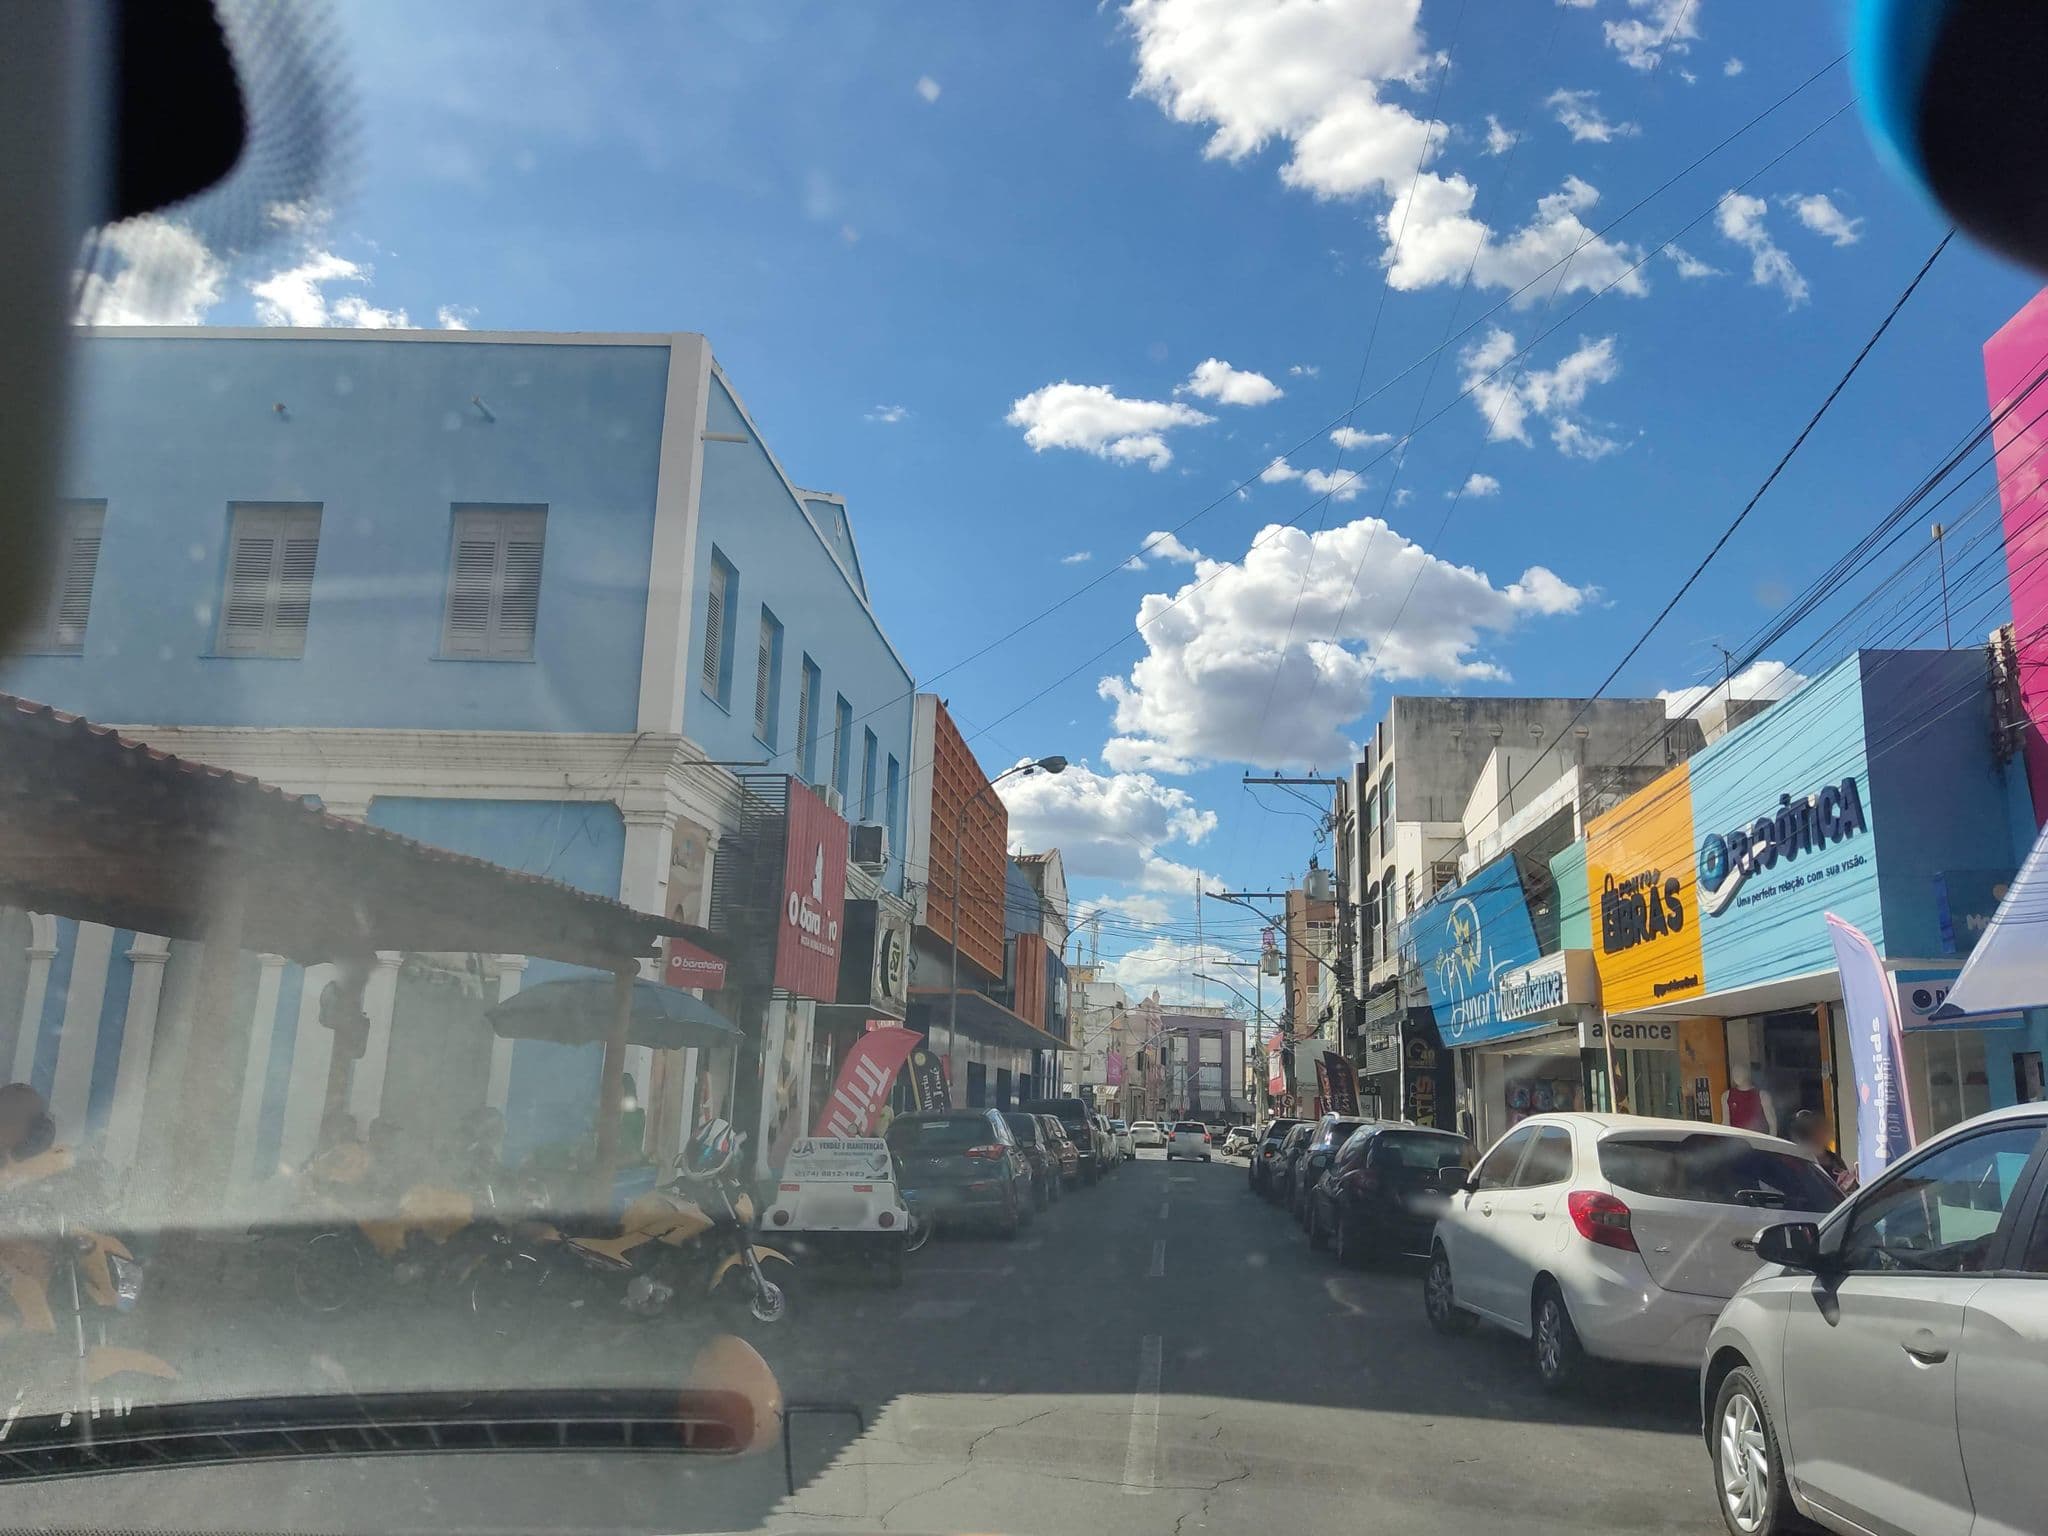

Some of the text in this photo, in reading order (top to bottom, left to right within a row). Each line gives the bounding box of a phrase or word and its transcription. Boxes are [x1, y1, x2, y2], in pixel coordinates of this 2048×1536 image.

[1736, 854, 1868, 908] Uma perfeita relação com sua visão.
[682, 958, 724, 971] barateiro
[1592, 1022, 1672, 1040] acance
[1871, 1016, 1891, 1159] Modakids
[1887, 1112, 1902, 1139] LOJA
